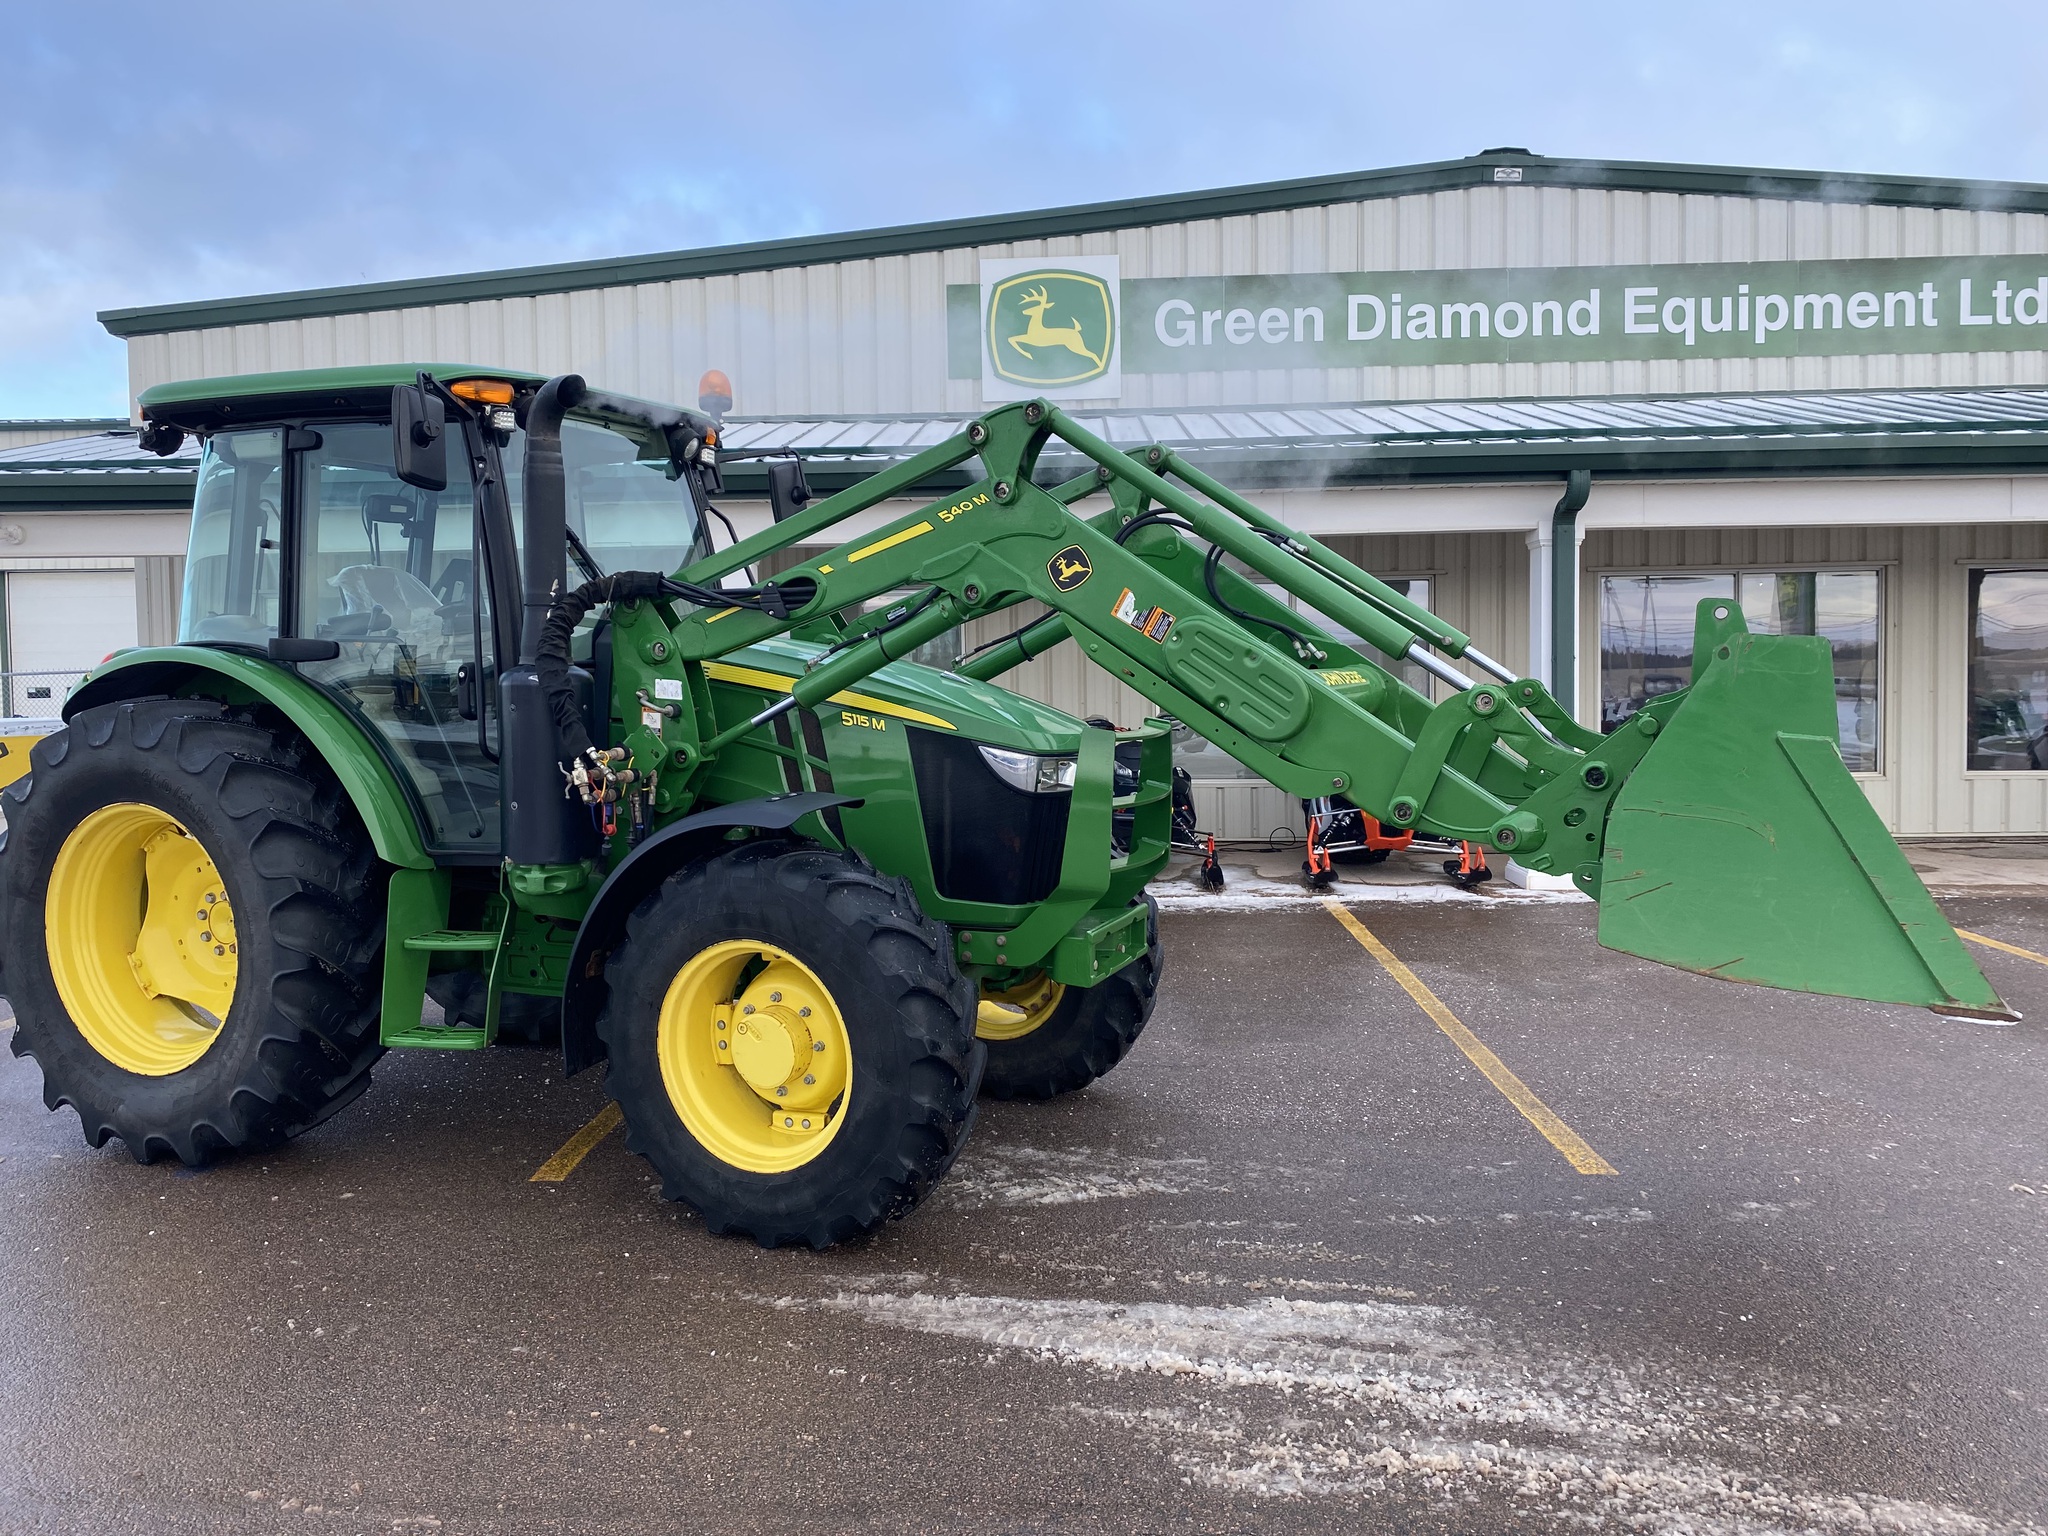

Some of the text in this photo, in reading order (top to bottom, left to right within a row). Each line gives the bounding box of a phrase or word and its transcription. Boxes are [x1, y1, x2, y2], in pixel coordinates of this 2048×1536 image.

[1154, 276, 2048, 348] Green Diamond Equipment Ltd
[937, 492, 991, 523] 540 M
[841, 711, 886, 731] 5115 M
